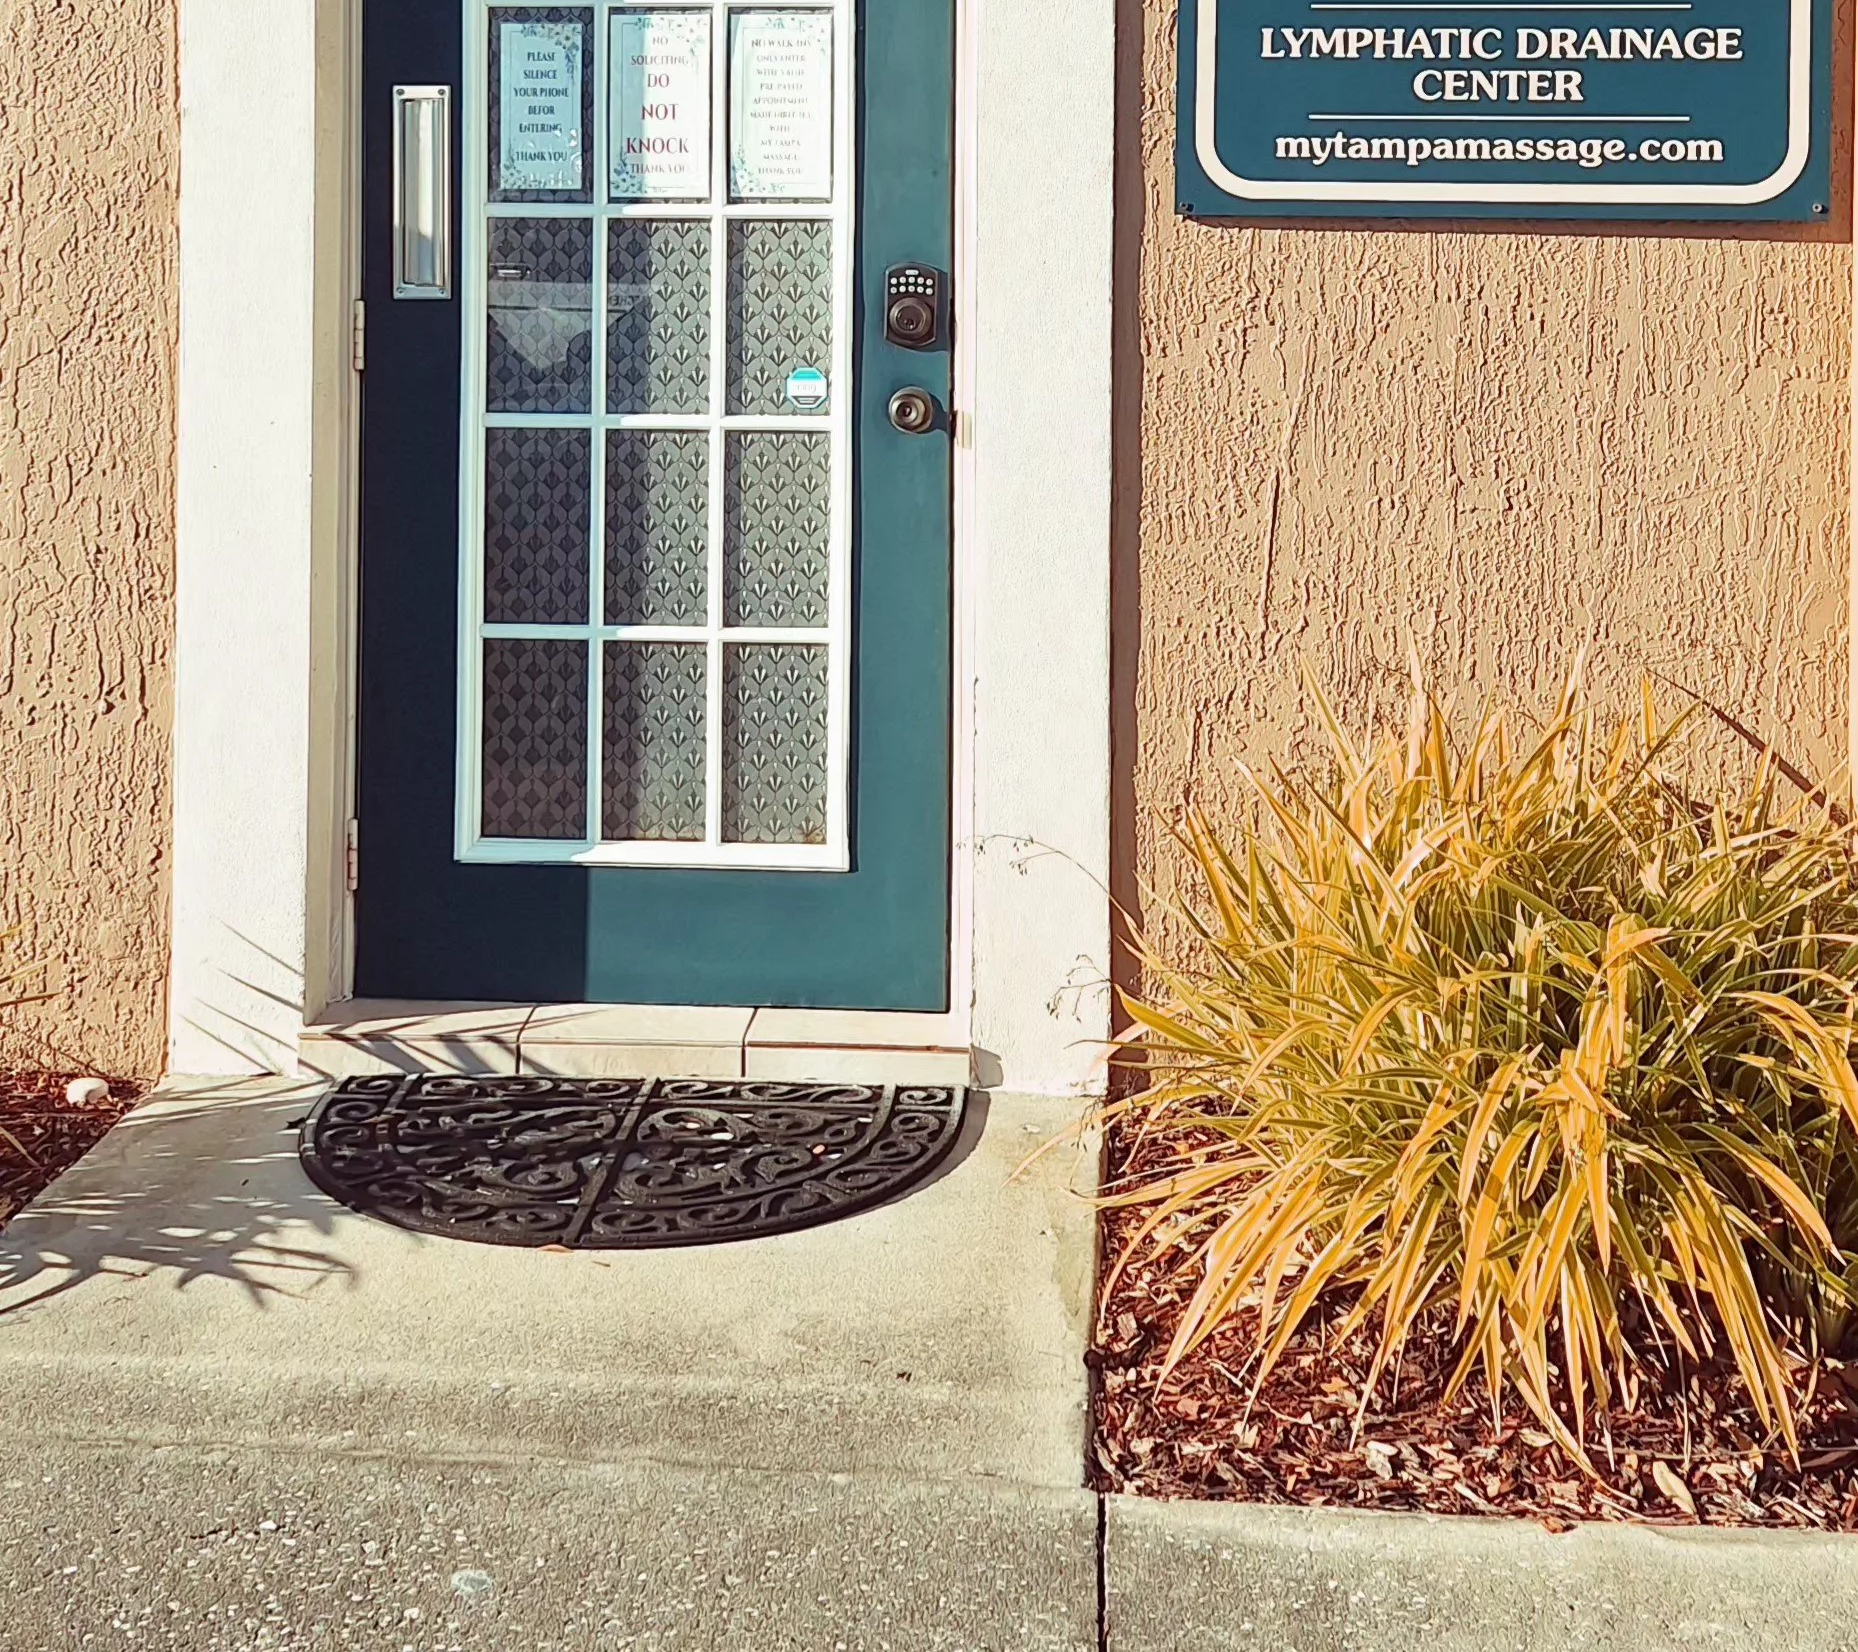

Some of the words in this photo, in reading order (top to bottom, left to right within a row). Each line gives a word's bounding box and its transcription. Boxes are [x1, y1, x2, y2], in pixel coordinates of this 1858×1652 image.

[652, 36, 669, 45] NO
[1261, 28, 1501, 59] LYMPHATIC
[1517, 28, 1742, 59] DRAINAGE
[527, 51, 556, 62] PLEASE
[631, 55, 689, 66] SOLICITING
[523, 69, 558, 80] SILENCE
[646, 73, 670, 88] DO
[1414, 70, 1583, 100] CENTER
[513, 87, 538, 98] YOUR
[539, 87, 569, 98] PHONE
[528, 105, 555, 115] BEFOR
[641, 103, 679, 121] NOT
[519, 123, 563, 134] ENTERING
[626, 137, 690, 154] KNOCK
[1276, 132, 1723, 167] mytampamassage.com
[515, 151, 546, 162] THANK
[547, 151, 568, 162] YOU
[630, 163, 665, 174] THANK
